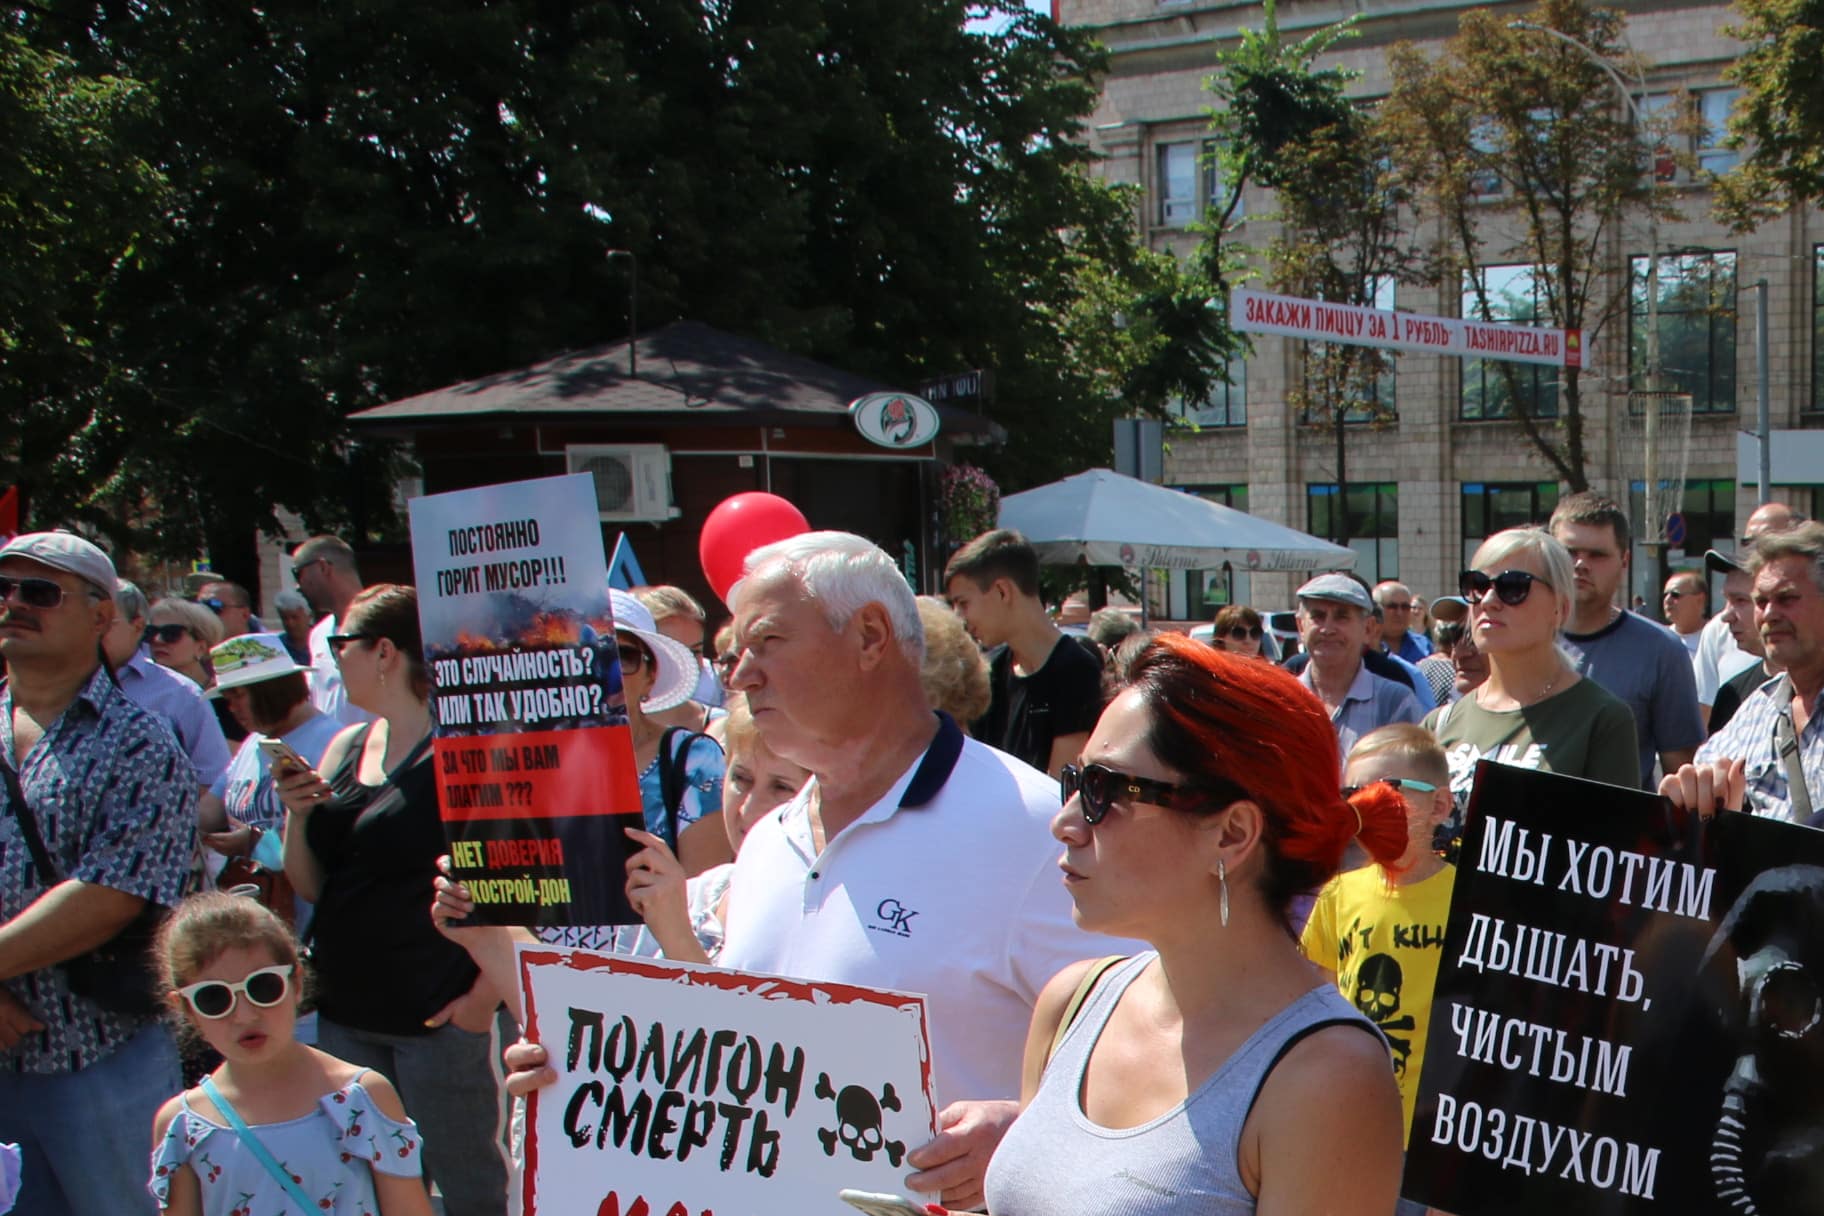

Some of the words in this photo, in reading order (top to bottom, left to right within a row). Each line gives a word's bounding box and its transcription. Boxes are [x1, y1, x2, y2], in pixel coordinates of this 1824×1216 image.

[1246, 297, 1311, 329] ЗАКАЖИ
[1315, 307, 1364, 336] ПИЦЦУ
[1368, 314, 1386, 339] ЗА
[1391, 313, 1400, 340] 1
[1464, 326, 1559, 356] TASHIRPIZZA.RU
[448, 519, 540, 556] ПОСТОЯННО
[437, 566, 480, 597] ГОРИТ
[484, 556, 567, 592] МУСОР!!!
[434, 659, 461, 688] ЭТО
[462, 647, 594, 686] СЛУЧАЙНОСТЬ?
[437, 694, 471, 726] ИЛИ
[473, 690, 508, 723] ТАК
[509, 684, 602, 724] УДОБНО?
[441, 749, 459, 775] ЗА
[460, 748, 487, 774] ЧТО
[490, 746, 519, 774] МЫ
[523, 744, 560, 771] ВАМ
[445, 783, 503, 809] ПЛАТИМ
[451, 840, 485, 869] НЕТ
[486, 838, 564, 869] ДОВЕРИЯ
[1477, 815, 1553, 887] МЫ
[1558, 839, 1716, 921] ХОТИМ
[1457, 913, 1651, 1011] ДЫШАТЬ,
[567, 1006, 805, 1118] ПОЛИГОН
[1450, 1002, 1632, 1098] ЧИСТЫМ
[563, 1080, 780, 1178] СМЕРТЬ
[1431, 1093, 1661, 1200] ВОЗДУХОМ
